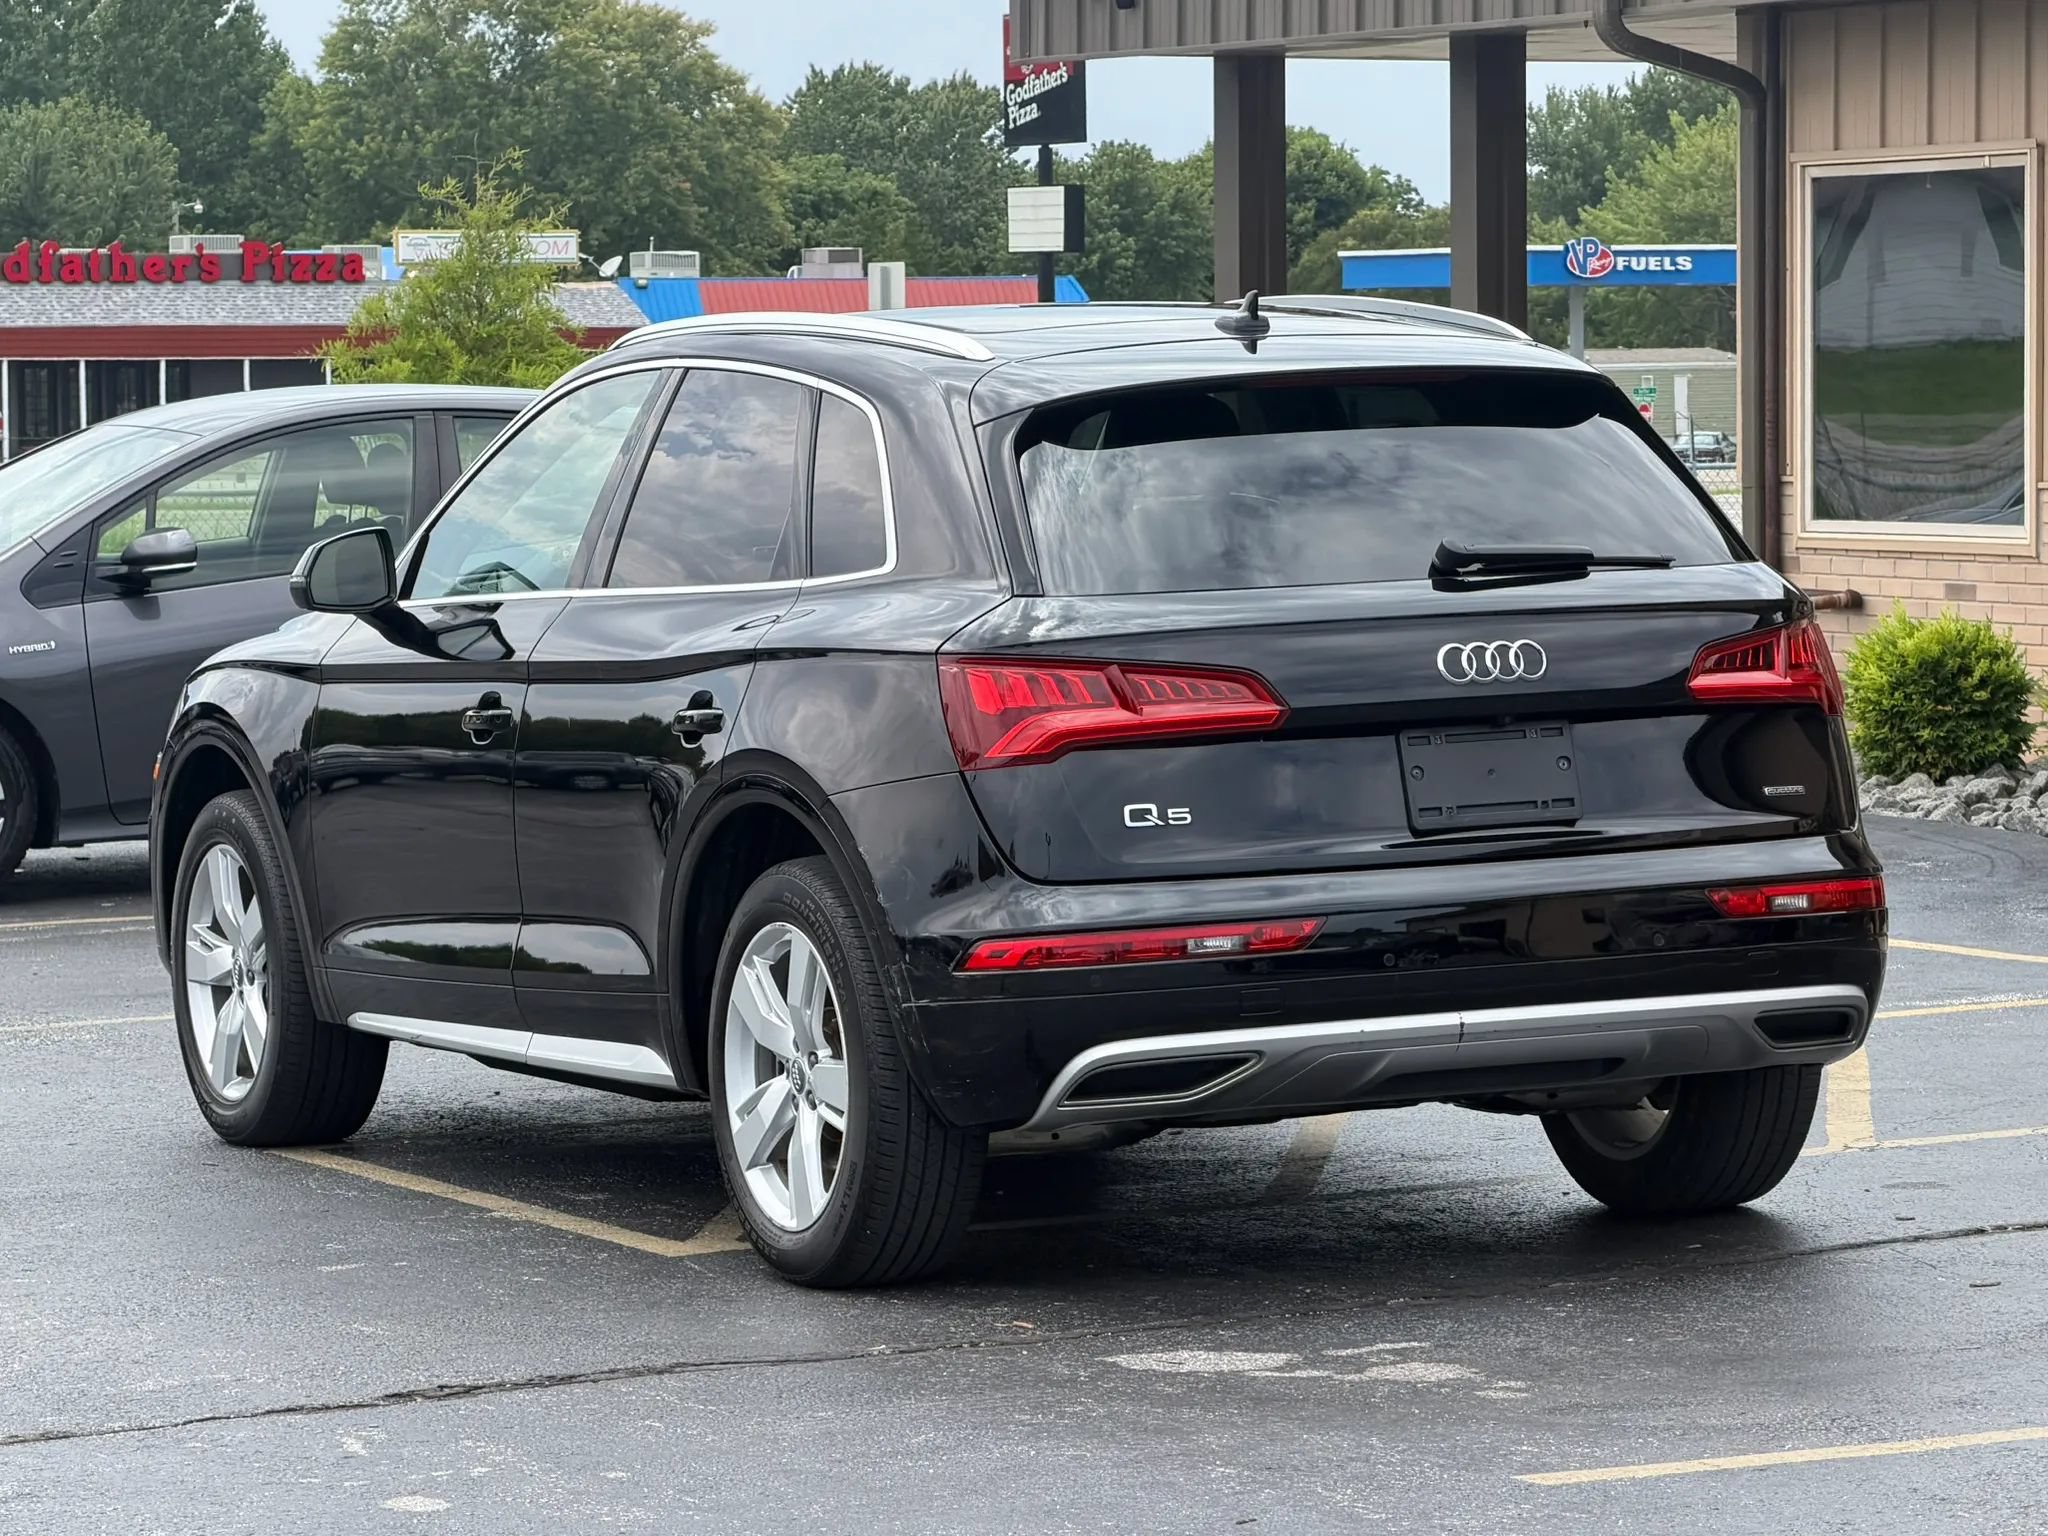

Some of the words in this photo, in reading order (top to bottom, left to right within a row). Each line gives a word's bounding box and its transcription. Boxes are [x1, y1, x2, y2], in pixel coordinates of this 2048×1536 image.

[1006, 62, 1069, 106] Godfather's
[1007, 102, 1038, 129] Pizza
[241, 240, 366, 283] Pizza
[1567, 237, 1601, 276] VP
[1616, 256, 1693, 271] FUELS
[9, 643, 48, 654] HYBRID
[1124, 803, 1192, 827] Q5
